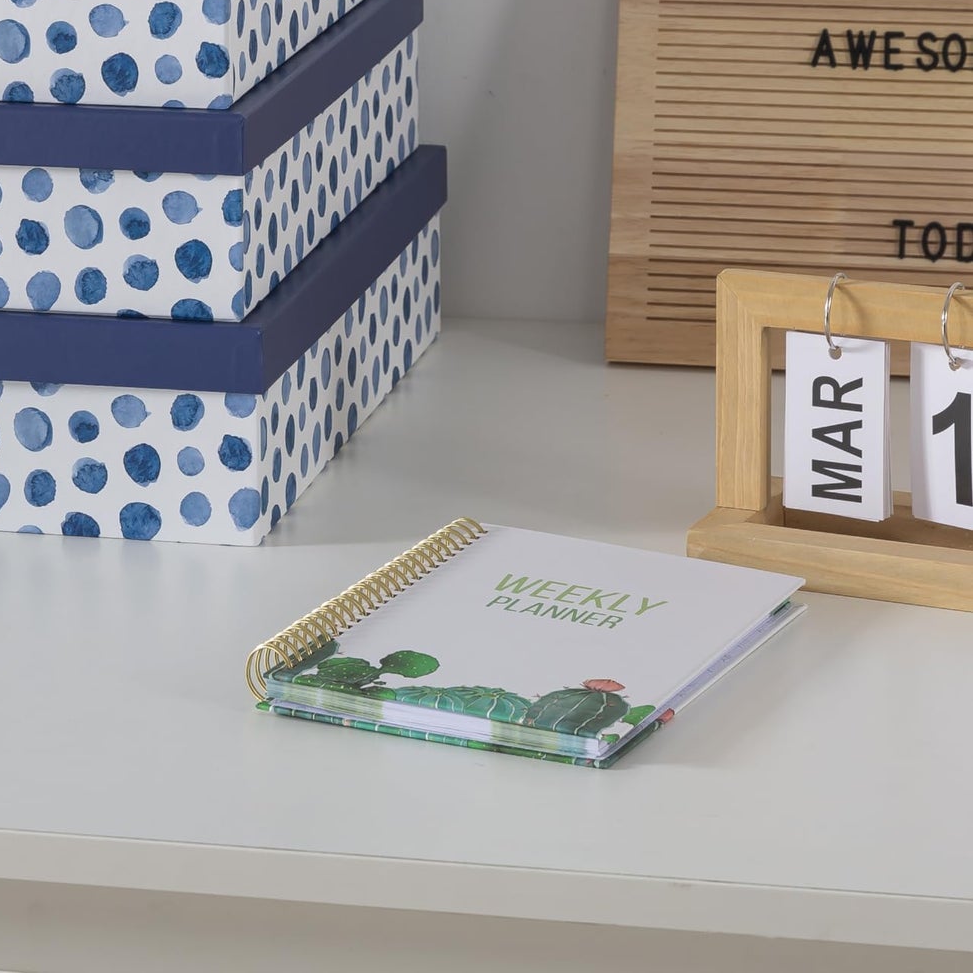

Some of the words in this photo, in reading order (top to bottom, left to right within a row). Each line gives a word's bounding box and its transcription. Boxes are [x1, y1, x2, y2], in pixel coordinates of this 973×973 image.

[811, 28, 967, 73] AWESO
[811, 375, 864, 503] MAR
[932, 392, 973, 507] 1
[485, 595, 624, 629] PLANNER
[494, 573, 669, 615] WEEKLY
